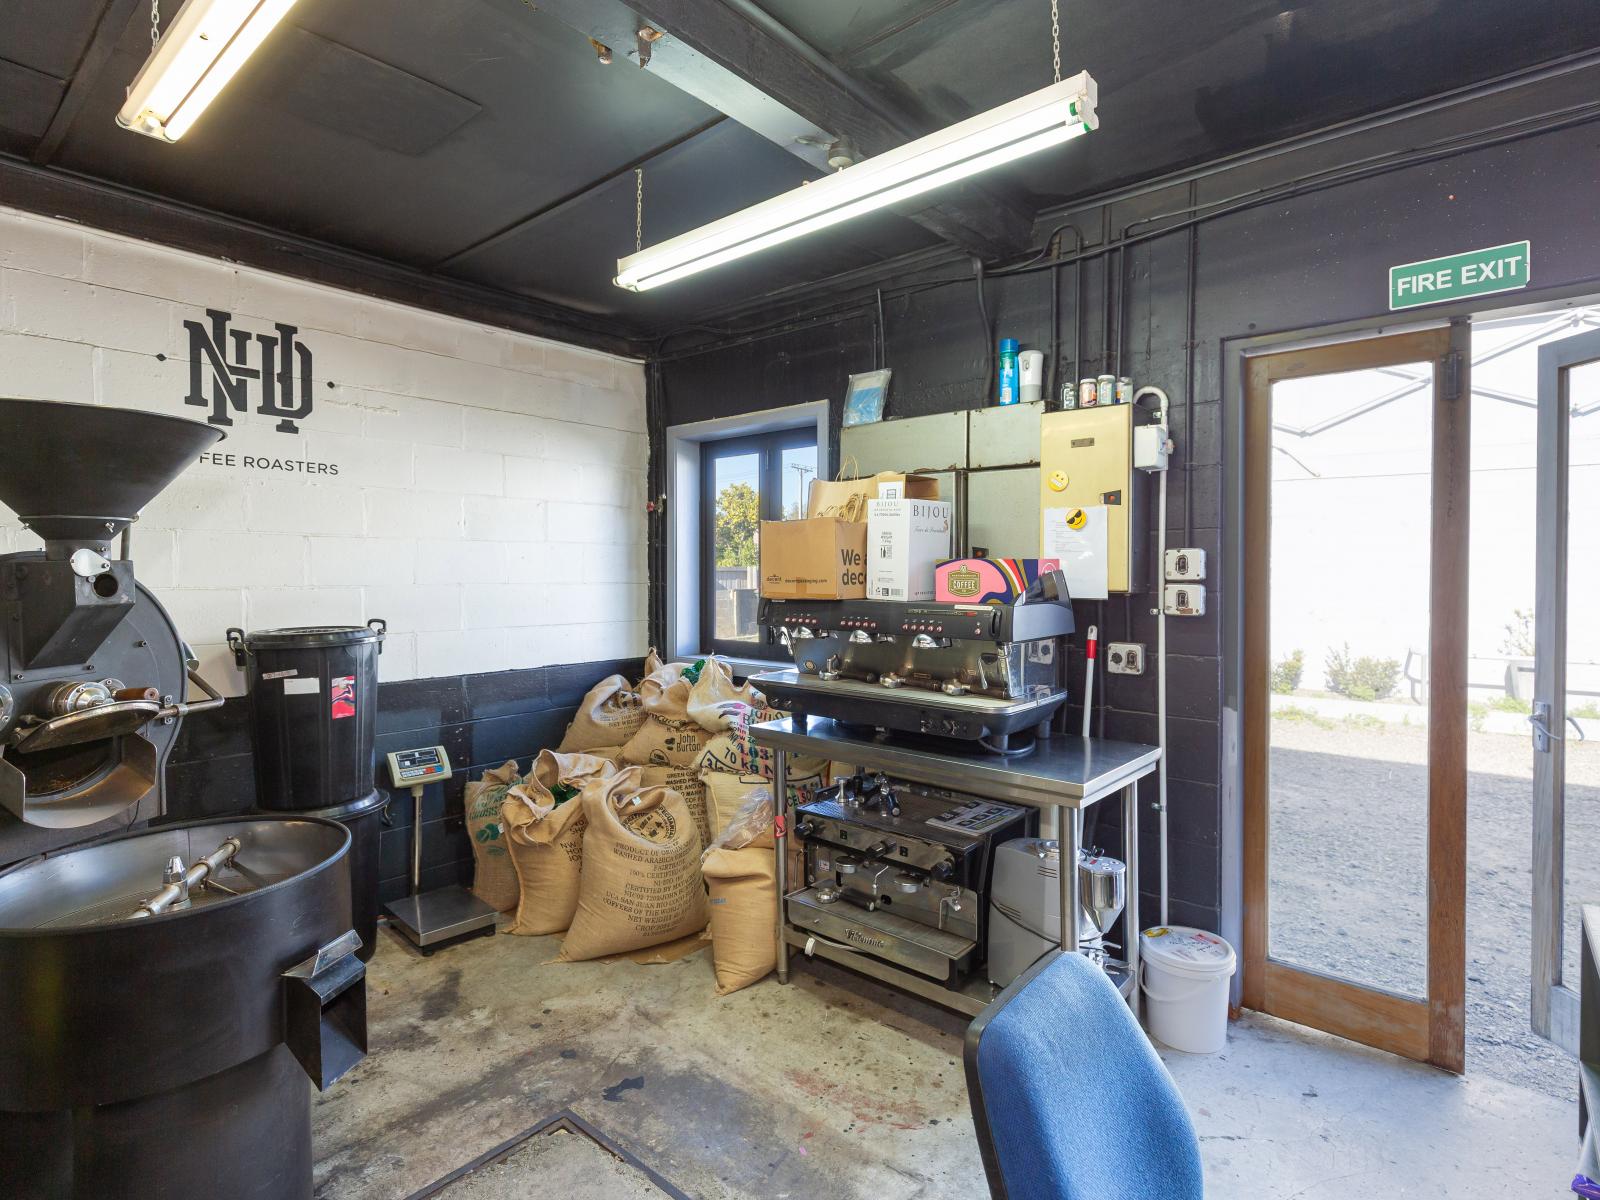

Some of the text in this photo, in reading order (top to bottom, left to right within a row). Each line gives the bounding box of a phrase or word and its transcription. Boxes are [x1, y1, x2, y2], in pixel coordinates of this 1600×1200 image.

[1398, 256, 1522, 296] FIRE EXIT
[244, 456, 340, 476] ROASTERS
[913, 504, 950, 518] BIJOU
[841, 548, 861, 566] We
[842, 568, 867, 586] dec
[953, 580, 976, 589] COFFEE
[680, 734, 696, 744] John
[677, 743, 701, 752] Burton
[725, 747, 737, 764] 70
[614, 848, 643, 862] WASHED
[616, 842, 649, 856] PRODUCT
